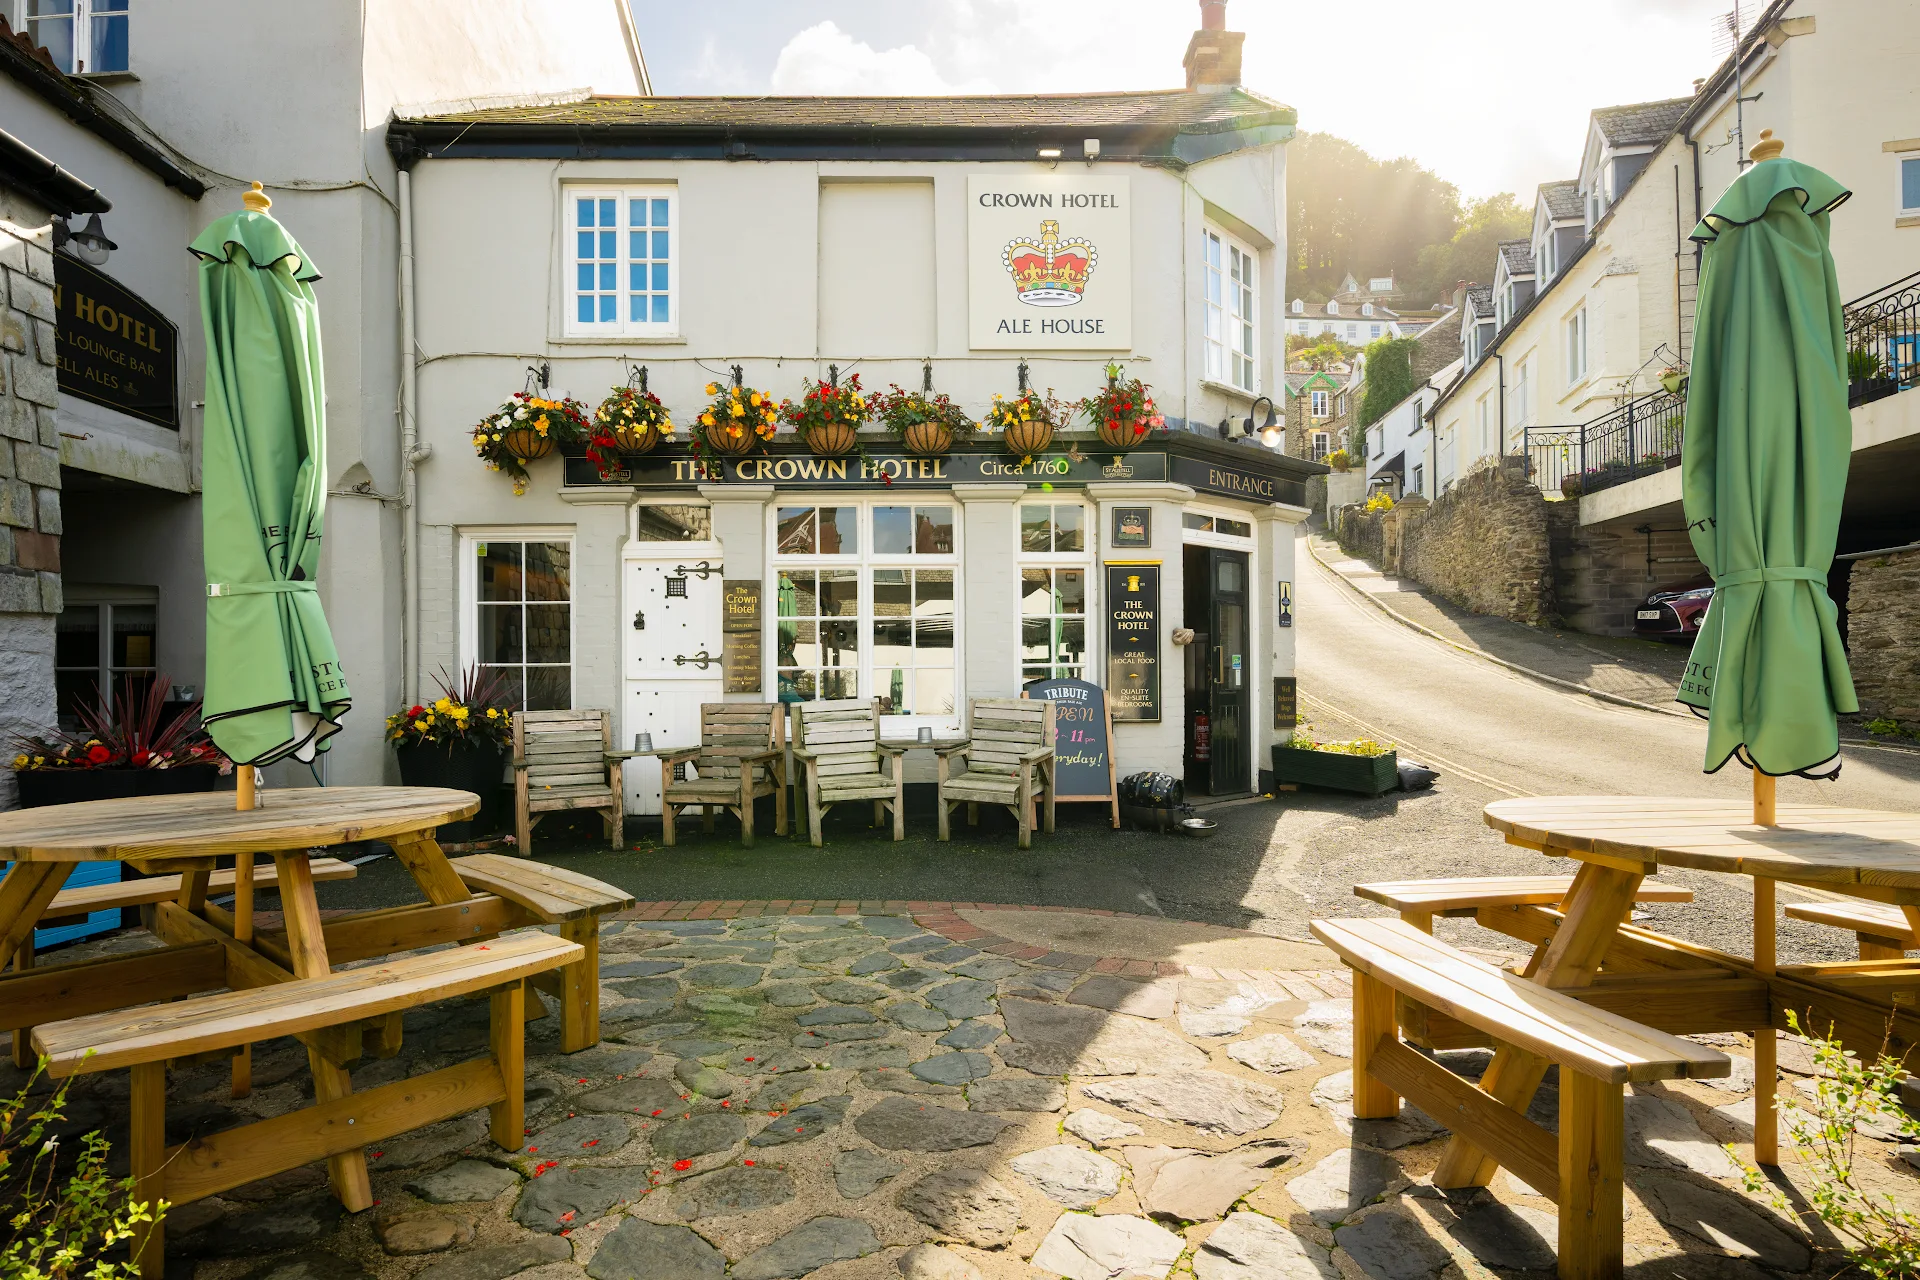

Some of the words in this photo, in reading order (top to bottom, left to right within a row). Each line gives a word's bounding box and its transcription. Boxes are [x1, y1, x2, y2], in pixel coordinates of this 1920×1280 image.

[979, 193, 1053, 208] CROWN
[1061, 193, 1119, 208] HOTEL
[75, 291, 161, 354] HOTEL
[996, 319, 1032, 334] ALE
[1041, 319, 1105, 334] HOUSE
[69, 331, 126, 366] LOUNGE
[130, 357, 156, 378] BAR
[56, 355, 80, 375] ELL
[84, 366, 119, 389] ALES
[670, 460, 724, 480] THE
[735, 459, 847, 480] CROWN
[860, 459, 948, 479] HOTEL
[980, 461, 1025, 475] Circa
[1032, 460, 1070, 475] 1760
[1209, 468, 1274, 497] ENTRANCE
[726, 594, 757, 604] Crown
[1123, 600, 1143, 609] THE
[729, 604, 755, 614] Hotel
[1113, 611, 1154, 620] CROWN
[1117, 622, 1149, 630] HOTEL
[1043, 687, 1089, 701] TRIBUTE
[1056, 706, 1094, 722] PEN
[1055, 750, 1103, 768] eryday!
